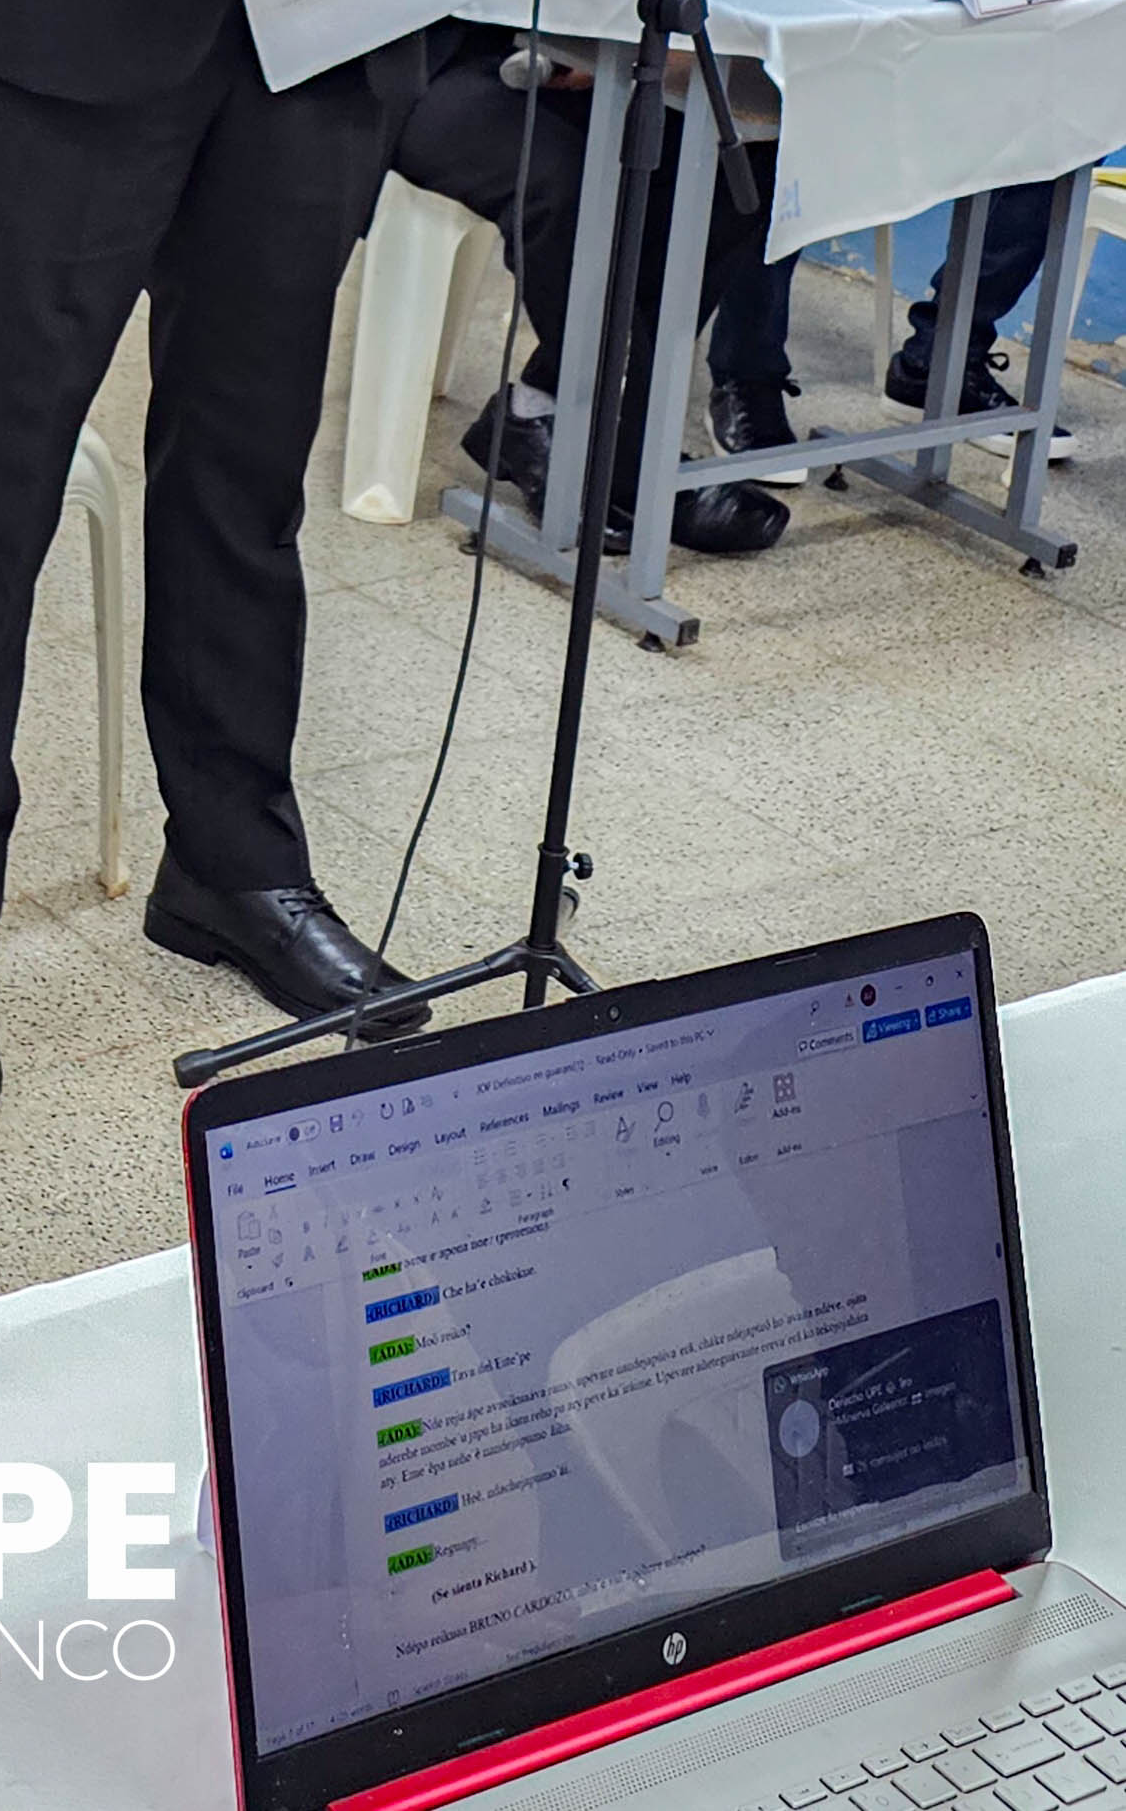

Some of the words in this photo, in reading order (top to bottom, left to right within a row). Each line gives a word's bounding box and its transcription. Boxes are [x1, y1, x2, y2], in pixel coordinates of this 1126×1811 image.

[226, 1184, 243, 1196] File
[263, 1172, 295, 1187] Home
[309, 1159, 335, 1175] Insert
[349, 1149, 376, 1165] Draw
[387, 1139, 421, 1156] Design
[433, 1127, 466, 1144] Layout
[479, 1112, 529, 1131] References
[542, 1100, 580, 1117] Mailings
[593, 1089, 624, 1103] Review
[636, 1081, 658, 1093] View
[670, 1072, 691, 1084] Help
[808, 1032, 854, 1051] Comments
[451, 1578, 482, 1595] sienta
[484, 1561, 527, 1585] Richard
[468, 1611, 511, 1633] BRUNO
